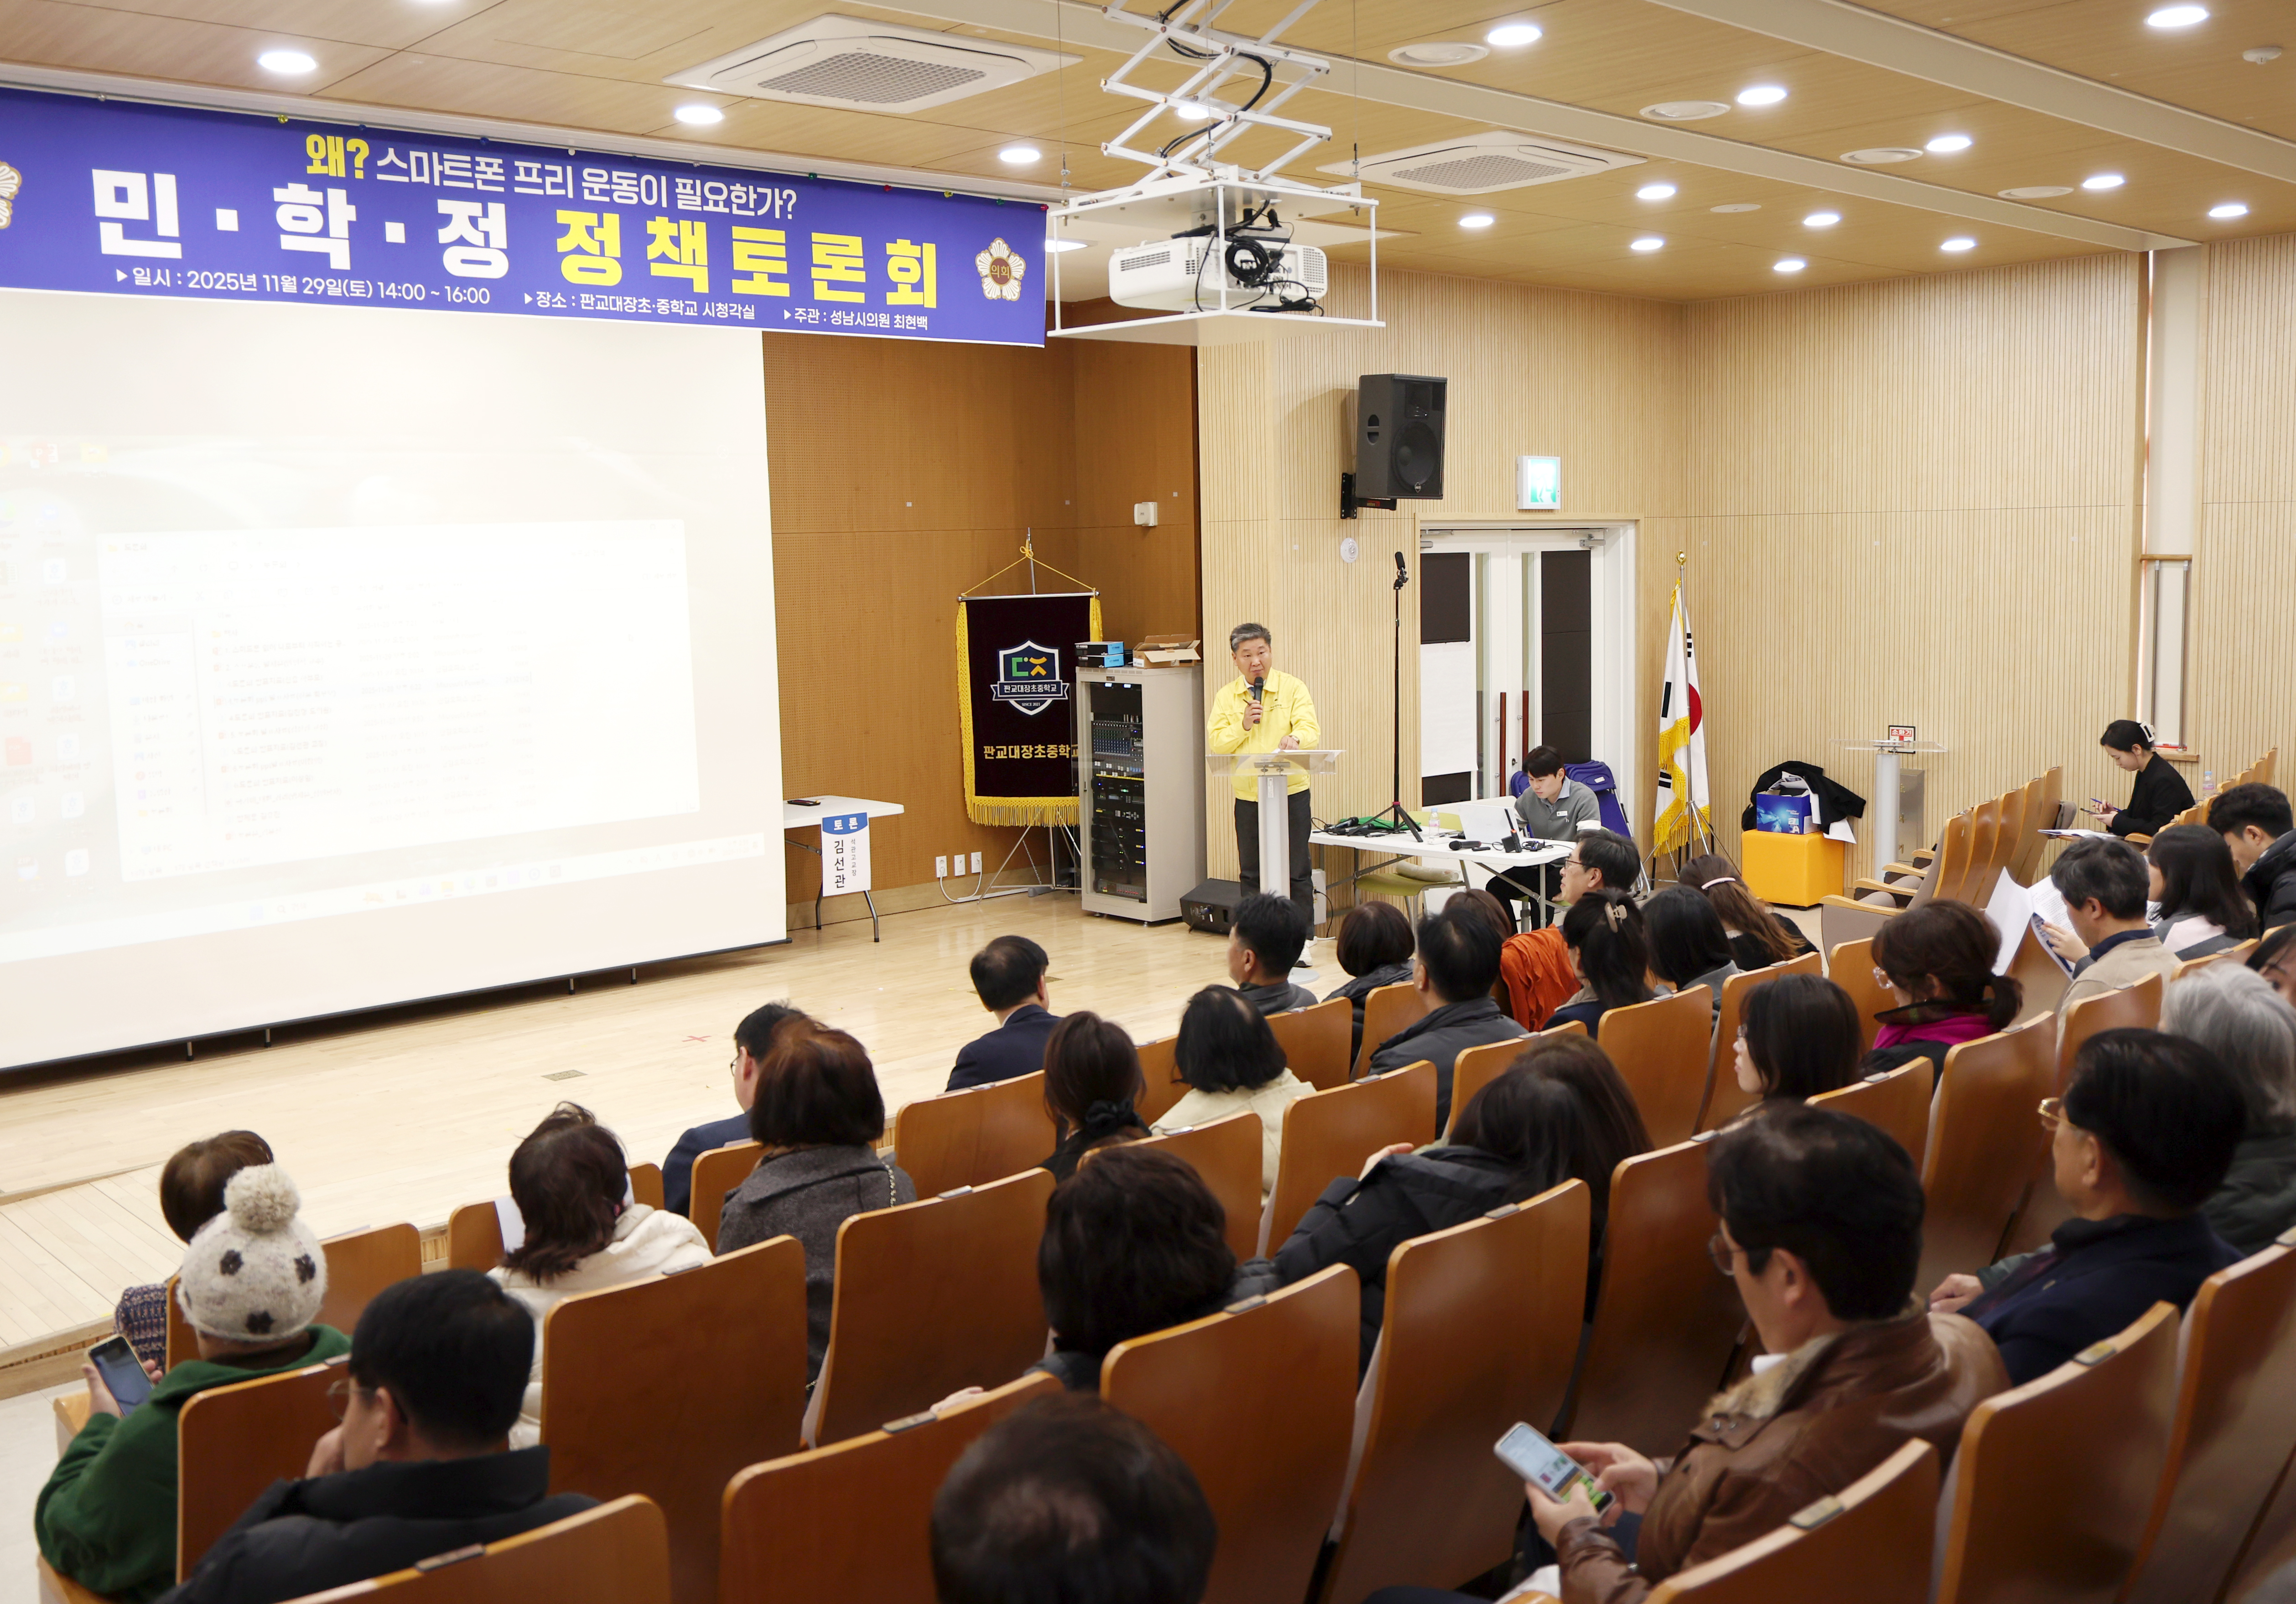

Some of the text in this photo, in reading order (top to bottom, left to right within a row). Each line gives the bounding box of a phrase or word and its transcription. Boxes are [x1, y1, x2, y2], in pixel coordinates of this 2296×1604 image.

[306, 135, 797, 219] 왜? 스마트폰 프리 운동이 필요한가?
[556, 210, 936, 307] 정책토론회
[991, 265, 1010, 279] 의회
[133, 267, 171, 287] 일시
[187, 271, 257, 291] 2025년
[263, 275, 297, 293] 11월
[302, 277, 373, 298] 29일(토)
[378, 282, 425, 300] 14:00
[444, 286, 490, 304] 16:00
[536, 292, 567, 308] 장소
[580, 294, 698, 316] 판교대장초·중학교
[702, 302, 755, 319] 시청각실
[795, 308, 820, 323] 주관
[830, 310, 890, 328] 성남시의원
[893, 314, 928, 330] 최현백
[1004, 684, 1057, 693] 판교대장초중학교
[834, 817, 858, 831] 토론
[834, 839, 846, 889] 김선관
